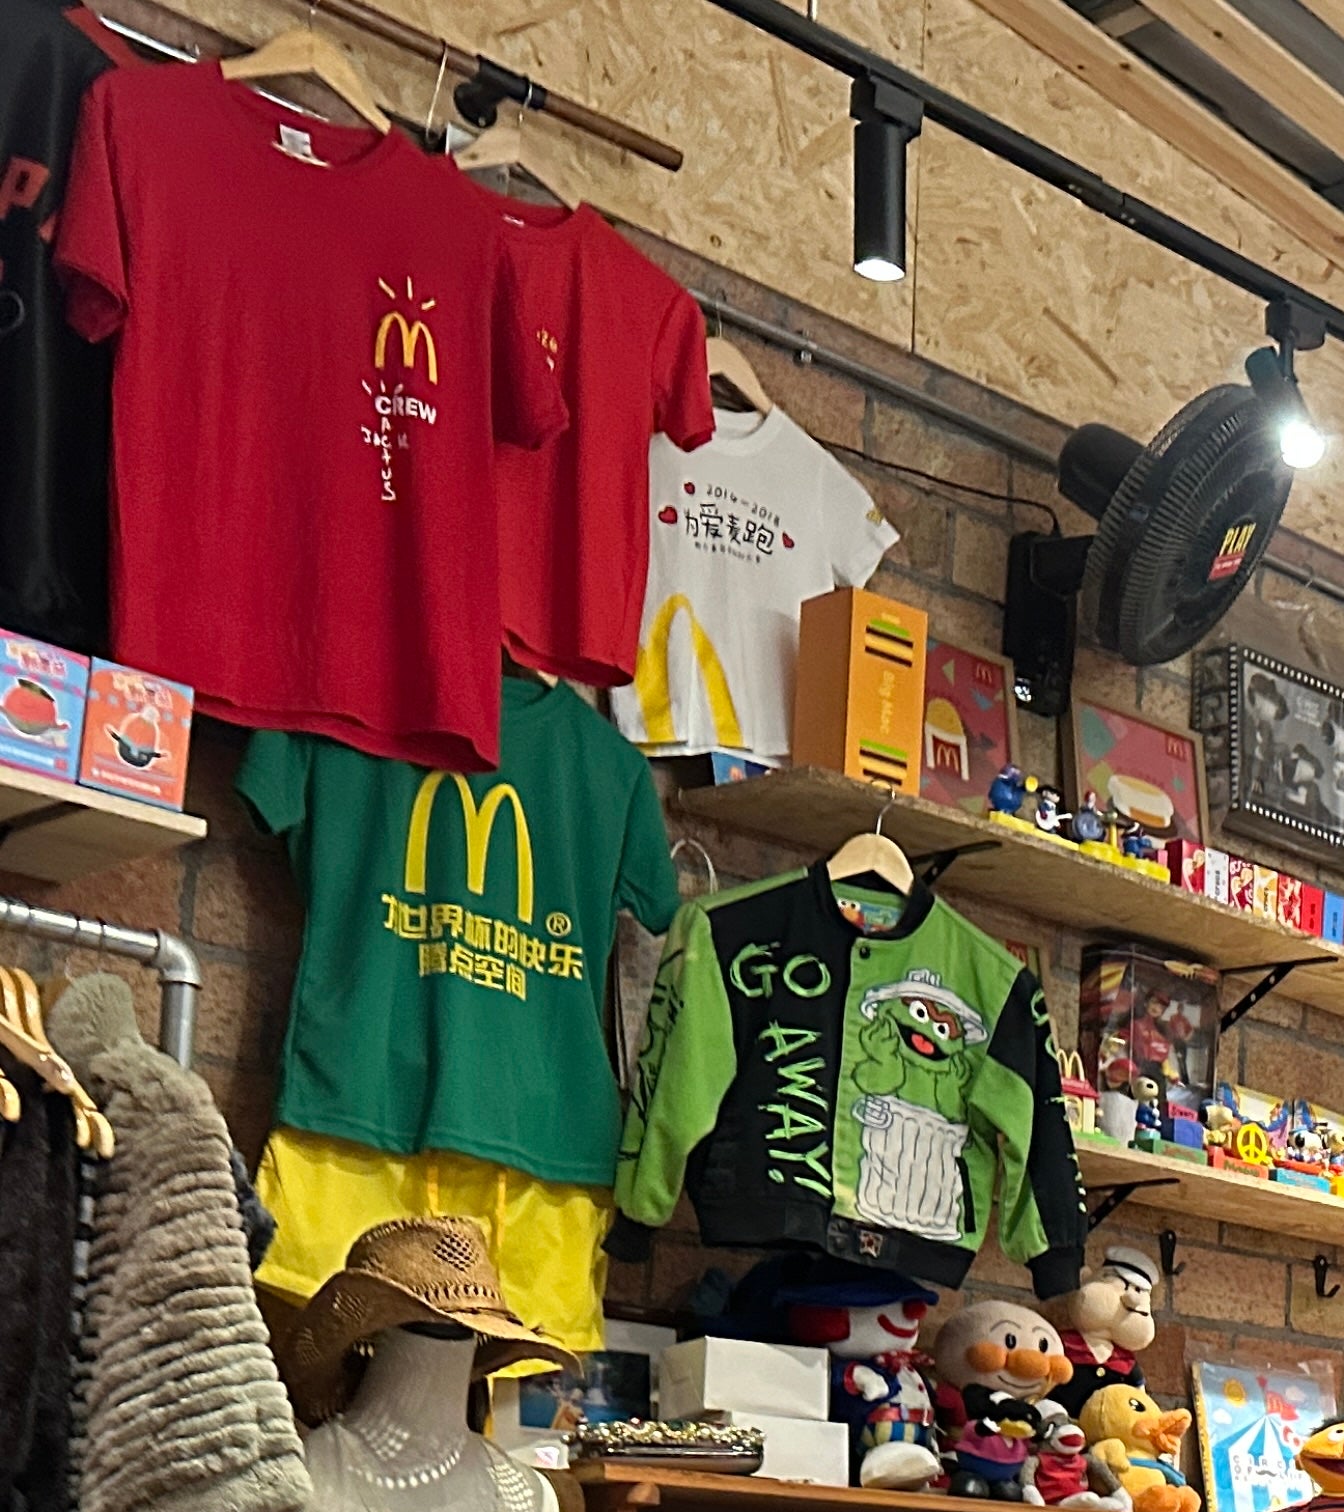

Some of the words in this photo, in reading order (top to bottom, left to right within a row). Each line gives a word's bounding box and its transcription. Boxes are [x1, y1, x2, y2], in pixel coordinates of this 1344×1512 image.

[374, 395, 437, 425] CREW
[1219, 522, 1257, 557] PLAY
[729, 940, 833, 999] GO
[756, 1018, 834, 1199] AWAY!
